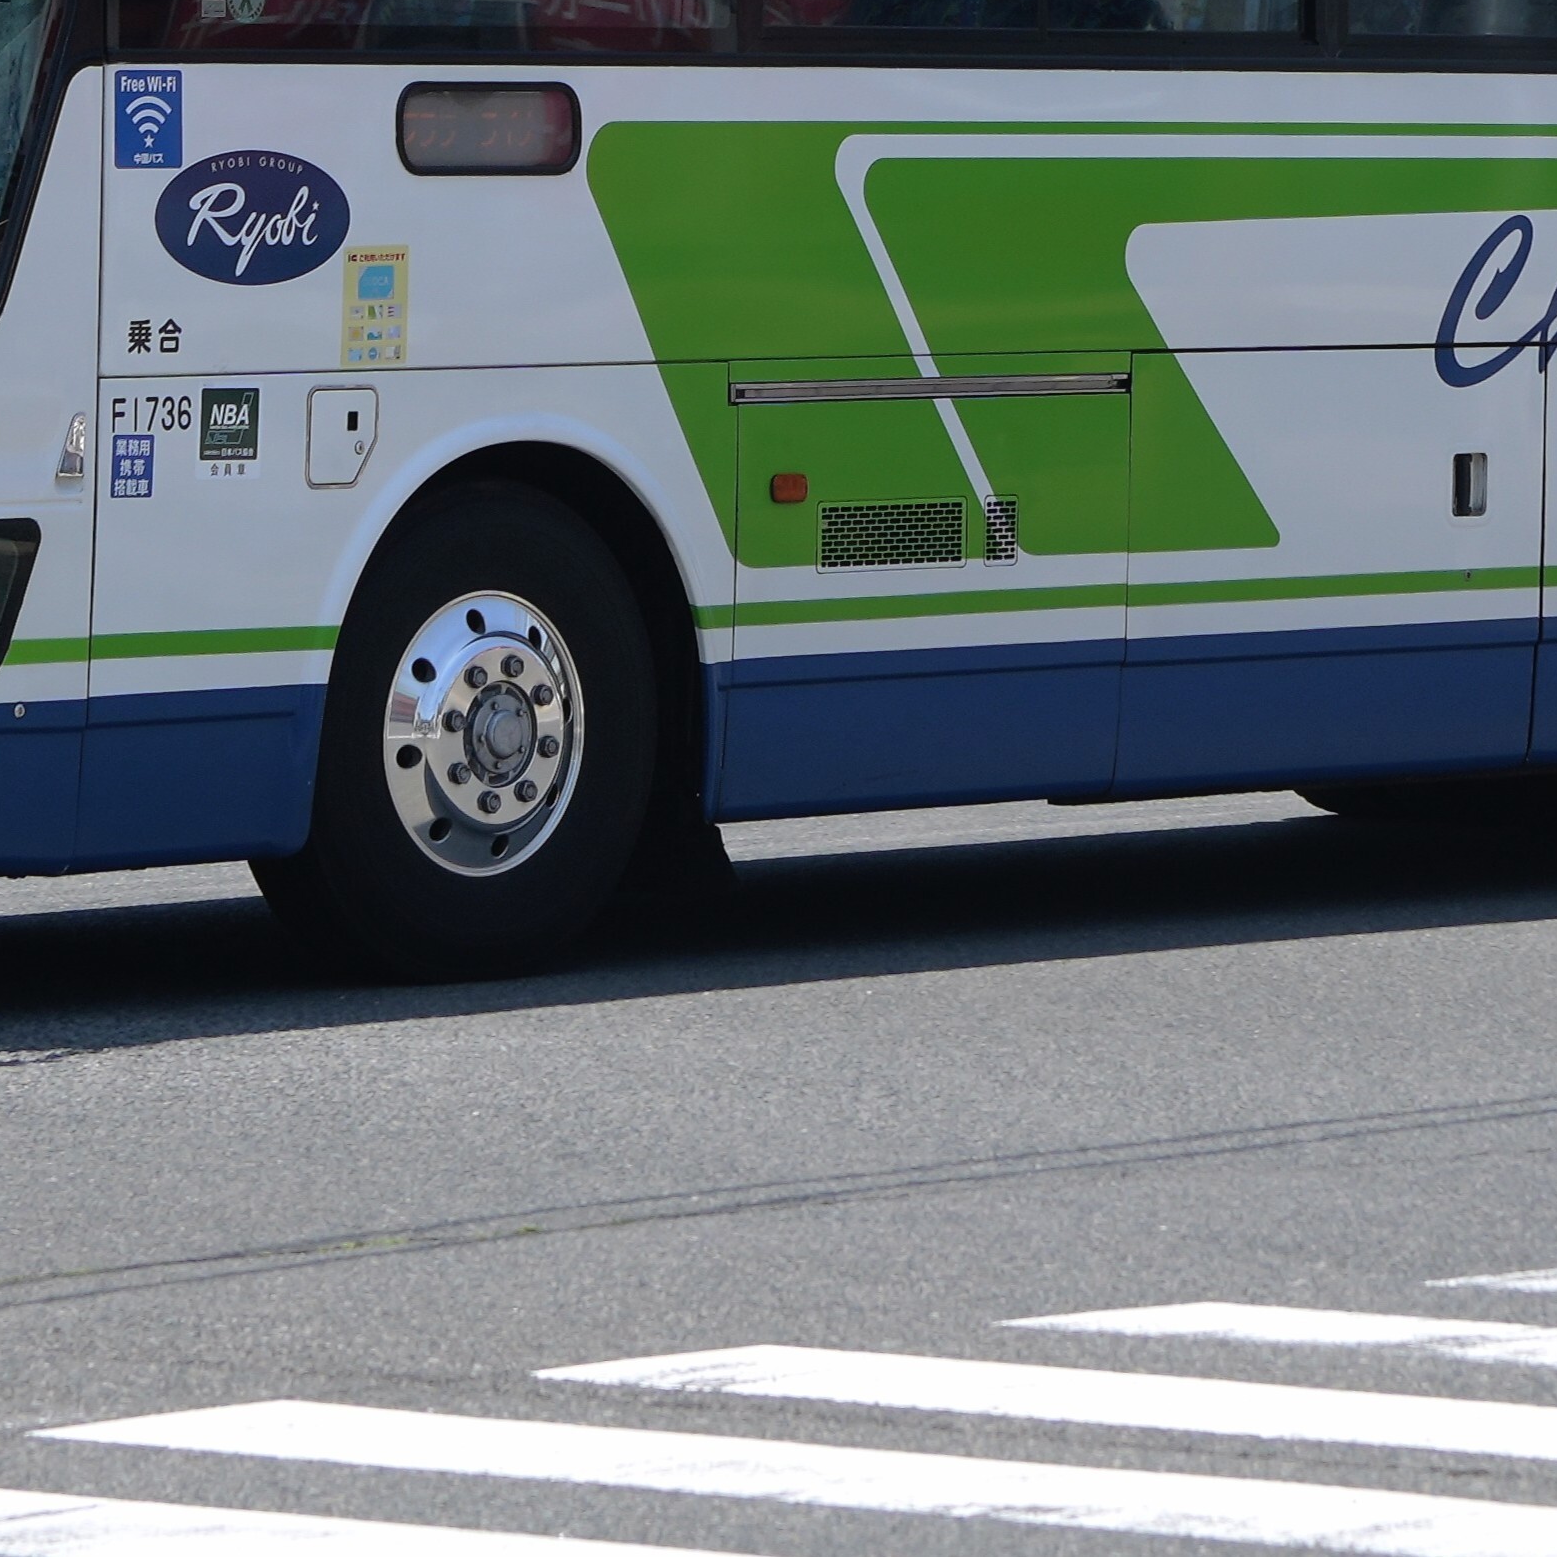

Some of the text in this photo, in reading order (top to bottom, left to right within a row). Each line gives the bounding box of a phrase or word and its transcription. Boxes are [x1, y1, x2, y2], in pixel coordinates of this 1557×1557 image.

[120, 74, 177, 93] Free Wi-Fi
[210, 155, 304, 175] RYOBI GROUP
[186, 182, 321, 278] Ryobi
[127, 318, 183, 355] 乗合
[111, 396, 192, 433] F1736
[209, 403, 251, 426] NBA
[115, 439, 151, 457] 業務用
